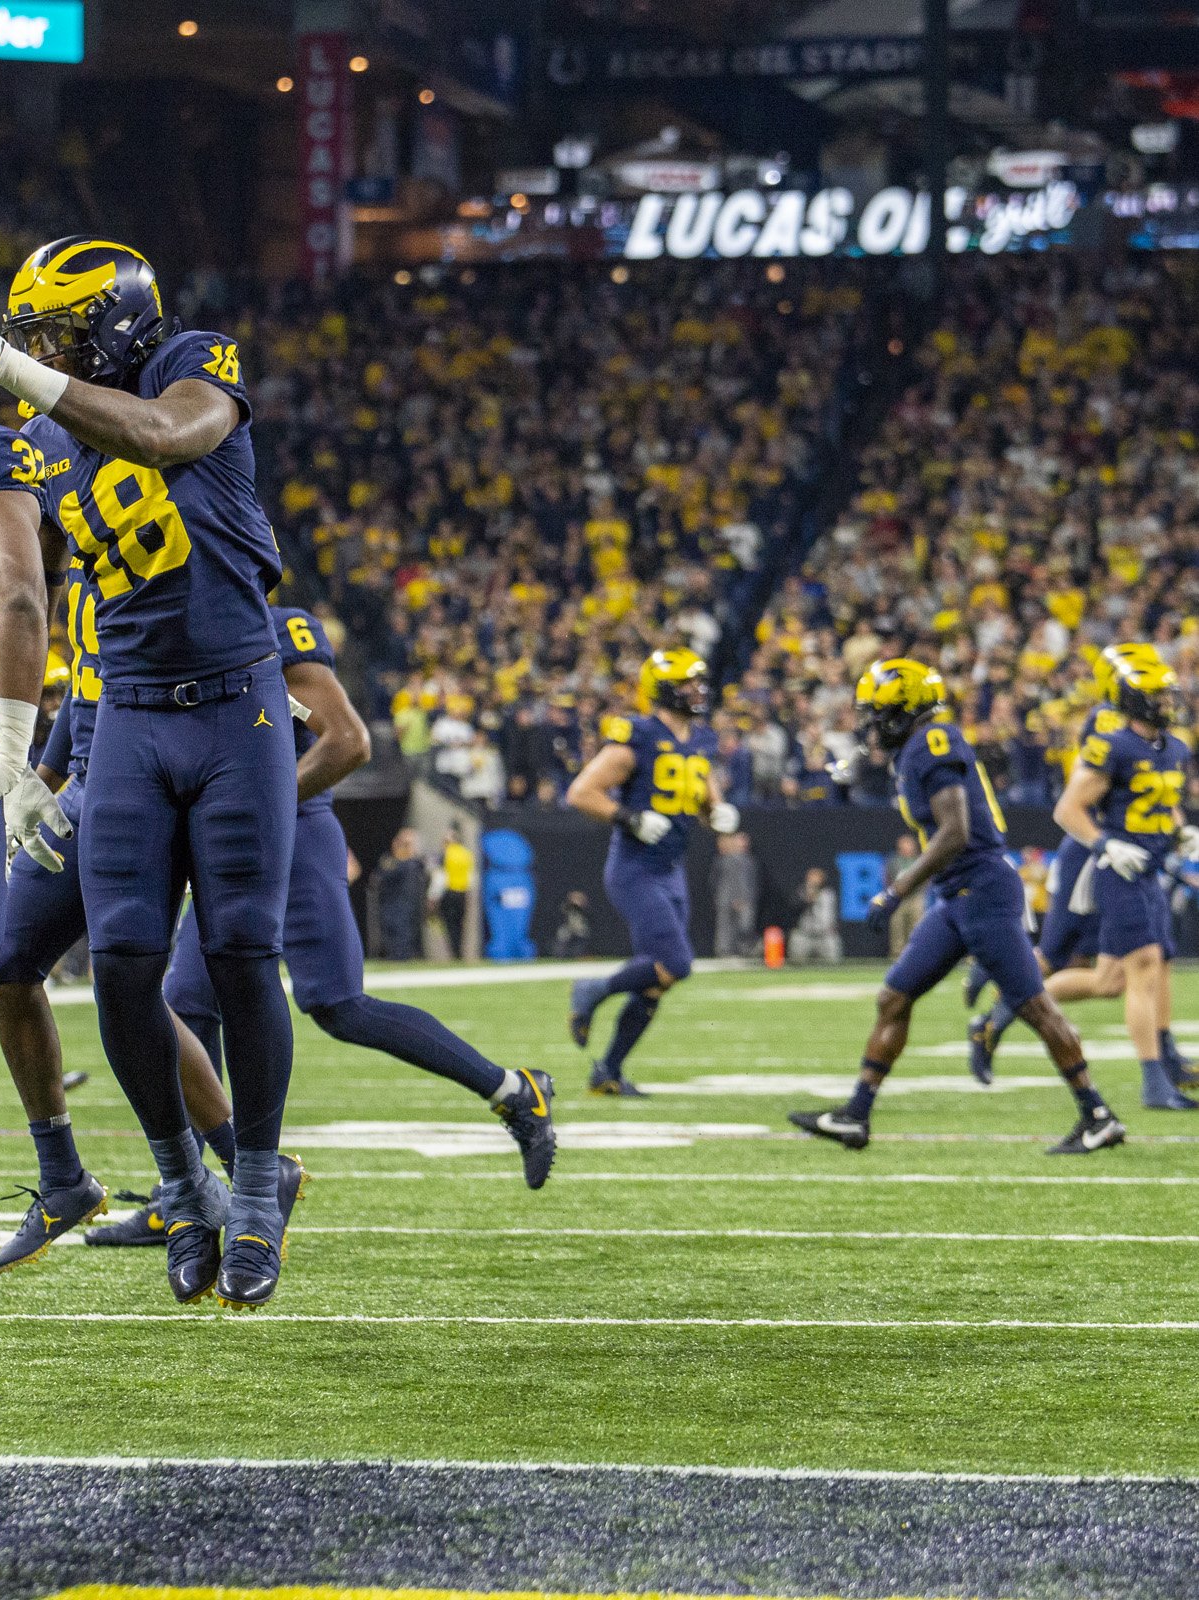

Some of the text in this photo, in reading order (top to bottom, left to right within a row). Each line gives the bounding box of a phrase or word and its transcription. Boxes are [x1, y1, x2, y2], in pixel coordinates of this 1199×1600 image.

[624, 187, 852, 259] LUCAS
[59, 457, 192, 600] 18
[286, 616, 317, 652] 6
[651, 753, 711, 815] 96
[1125, 771, 1186, 834] 25
